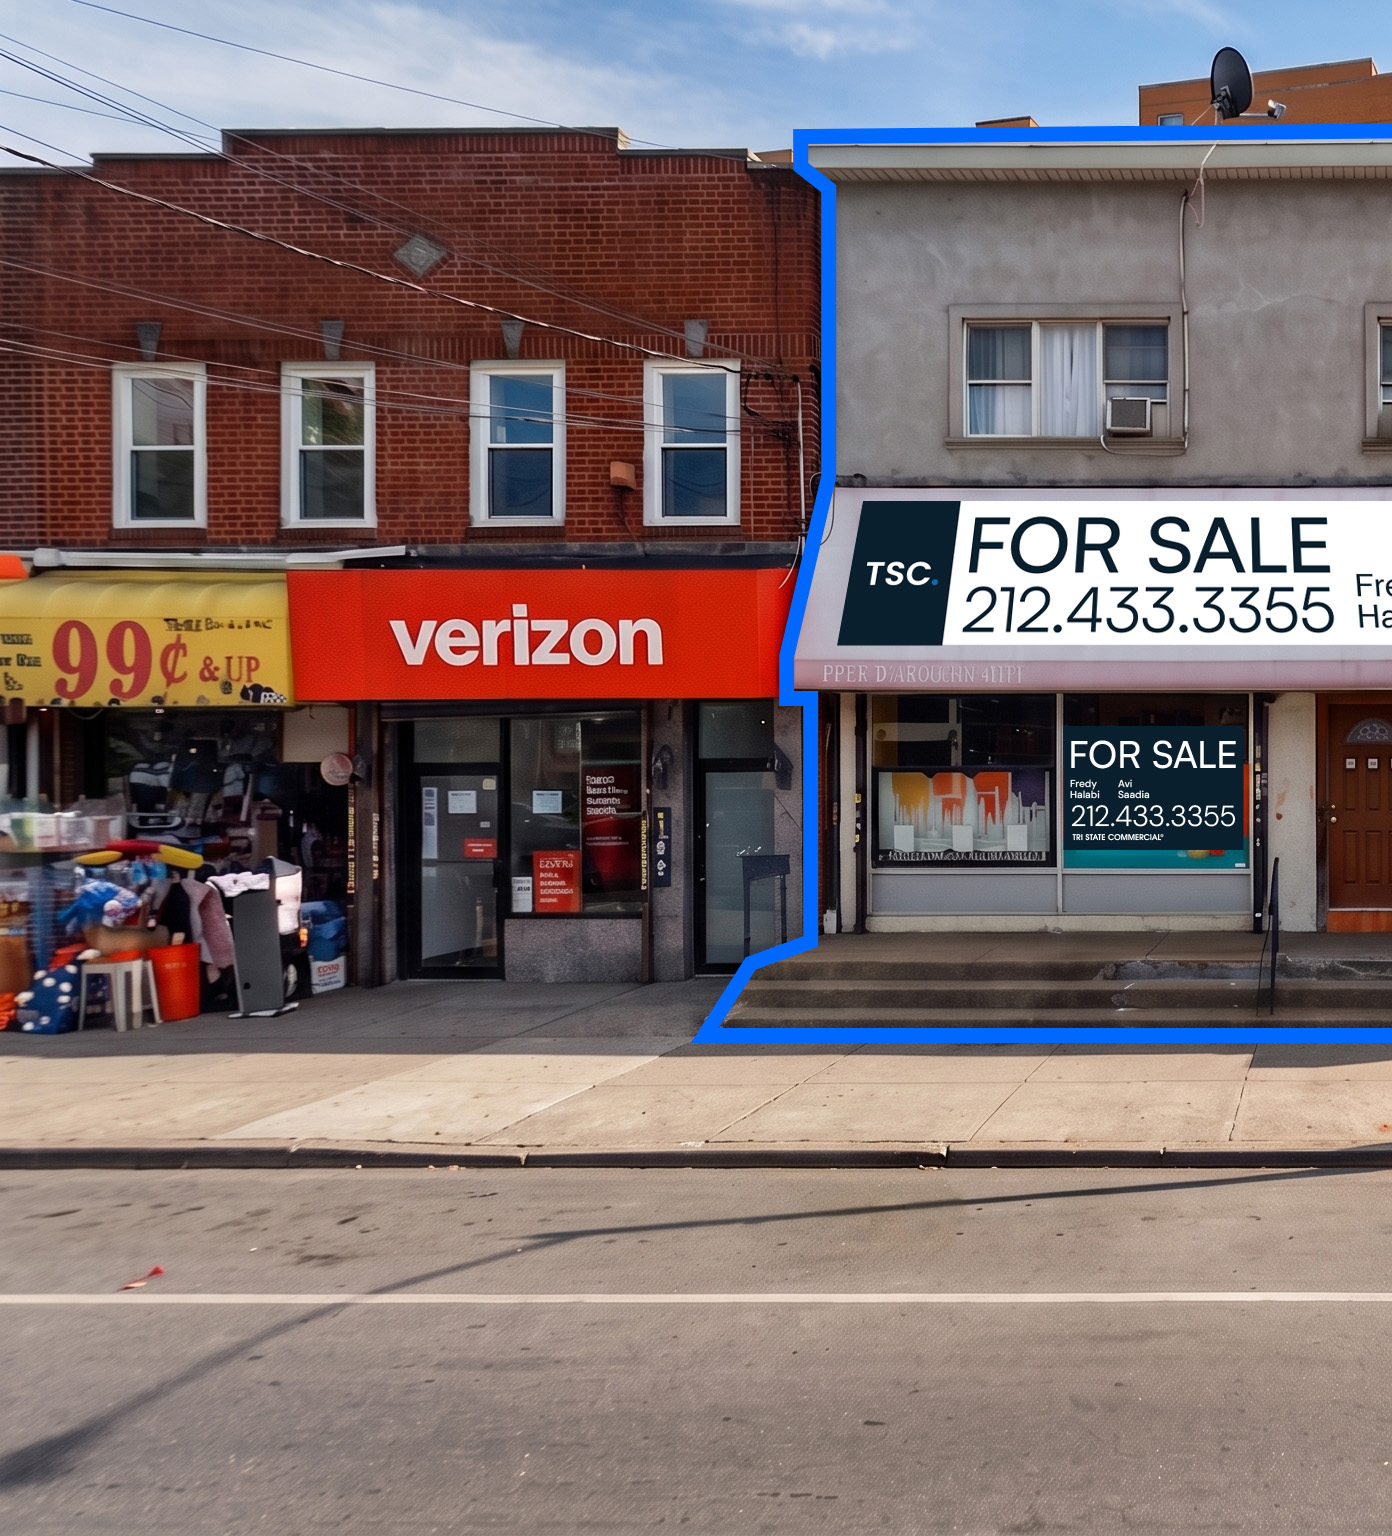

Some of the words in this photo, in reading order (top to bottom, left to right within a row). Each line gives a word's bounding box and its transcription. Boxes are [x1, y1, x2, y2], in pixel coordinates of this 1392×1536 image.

[968, 515, 1121, 574] FOR
[1148, 515, 1332, 575] SALE
[866, 561, 939, 586] TSC.
[961, 586, 1335, 634] 212.433.3355
[389, 603, 663, 666] verizon
[199, 656, 220, 682] &
[225, 655, 261, 683] UP
[1069, 740, 1141, 769] FOR
[1152, 740, 1237, 769] SALE
[1070, 779, 1097, 790] Fredy
[1118, 779, 1133, 788] Avi
[1070, 790, 1100, 799] Halabi
[1118, 790, 1150, 799] Saadia
[1071, 805, 1236, 827] 212.433.3355
[1072, 833, 1084, 841] TRI
[1085, 833, 1106, 841] STATE
